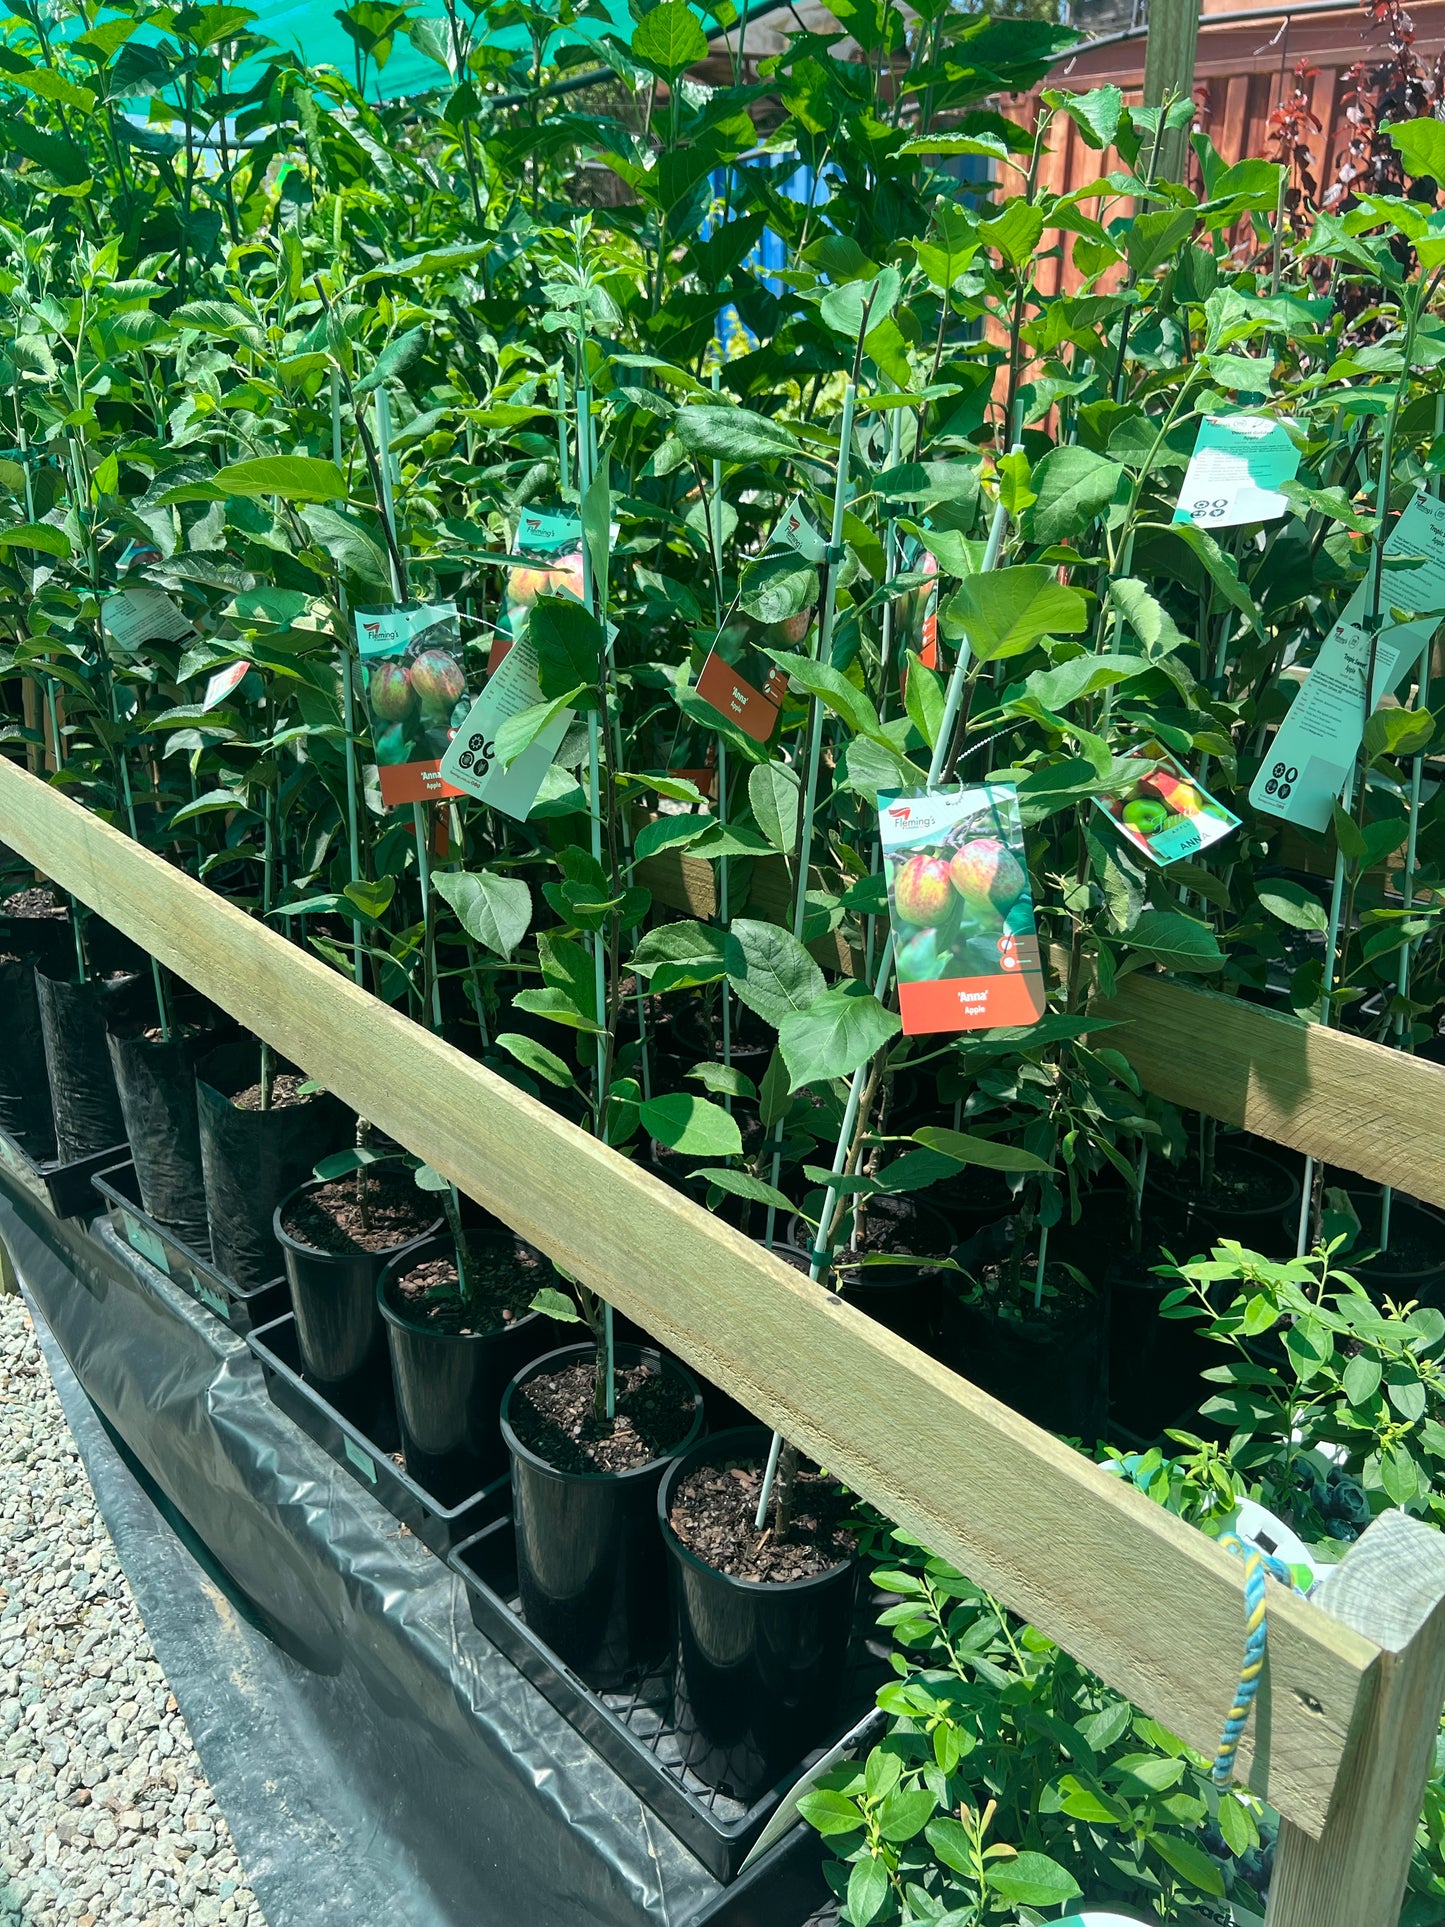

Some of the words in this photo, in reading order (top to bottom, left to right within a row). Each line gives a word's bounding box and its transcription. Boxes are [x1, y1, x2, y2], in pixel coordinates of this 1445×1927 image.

[368, 631, 399, 640] Fleming's
[732, 686, 749, 705] 'Anna'
[731, 701, 742, 714] Apple
[426, 782, 442, 790] Apple
[895, 815, 936, 828] Fleming's
[1180, 832, 1211, 851] ANNA
[957, 989, 989, 1003] 'Anna'
[964, 1005, 986, 1016] Apple
